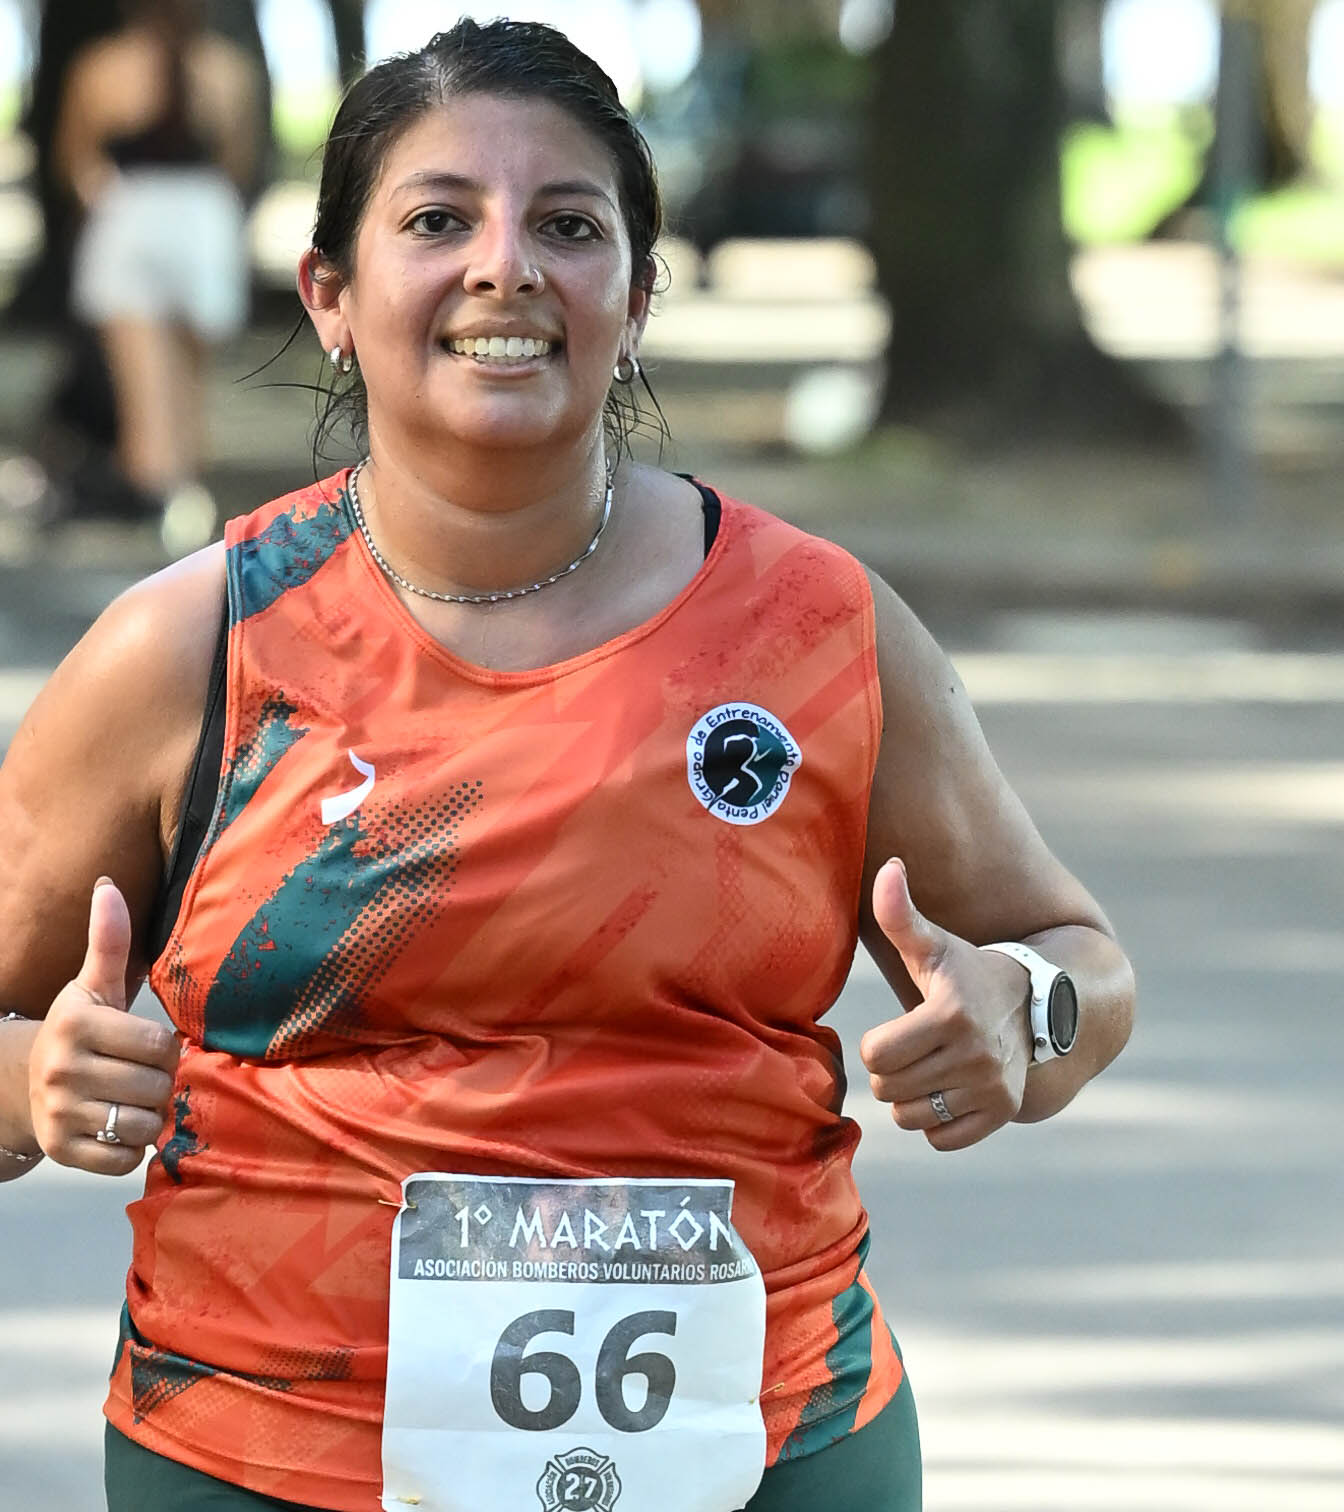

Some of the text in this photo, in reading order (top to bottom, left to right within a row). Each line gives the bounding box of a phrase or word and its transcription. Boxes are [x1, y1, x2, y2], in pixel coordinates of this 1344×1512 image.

[690, 729, 707, 747] de
[693, 751, 716, 801] Grupo
[761, 769, 790, 814] Daniel
[717, 802, 759, 820] Penta
[509, 1196, 732, 1252] MARATÓN
[414, 1256, 508, 1279] ASOCIACIÓN
[513, 1261, 599, 1280] BOMBEROS
[603, 1263, 705, 1282] VOLUNTARIOS
[490, 1308, 676, 1434] 66
[564, 1472, 598, 1501] 27
